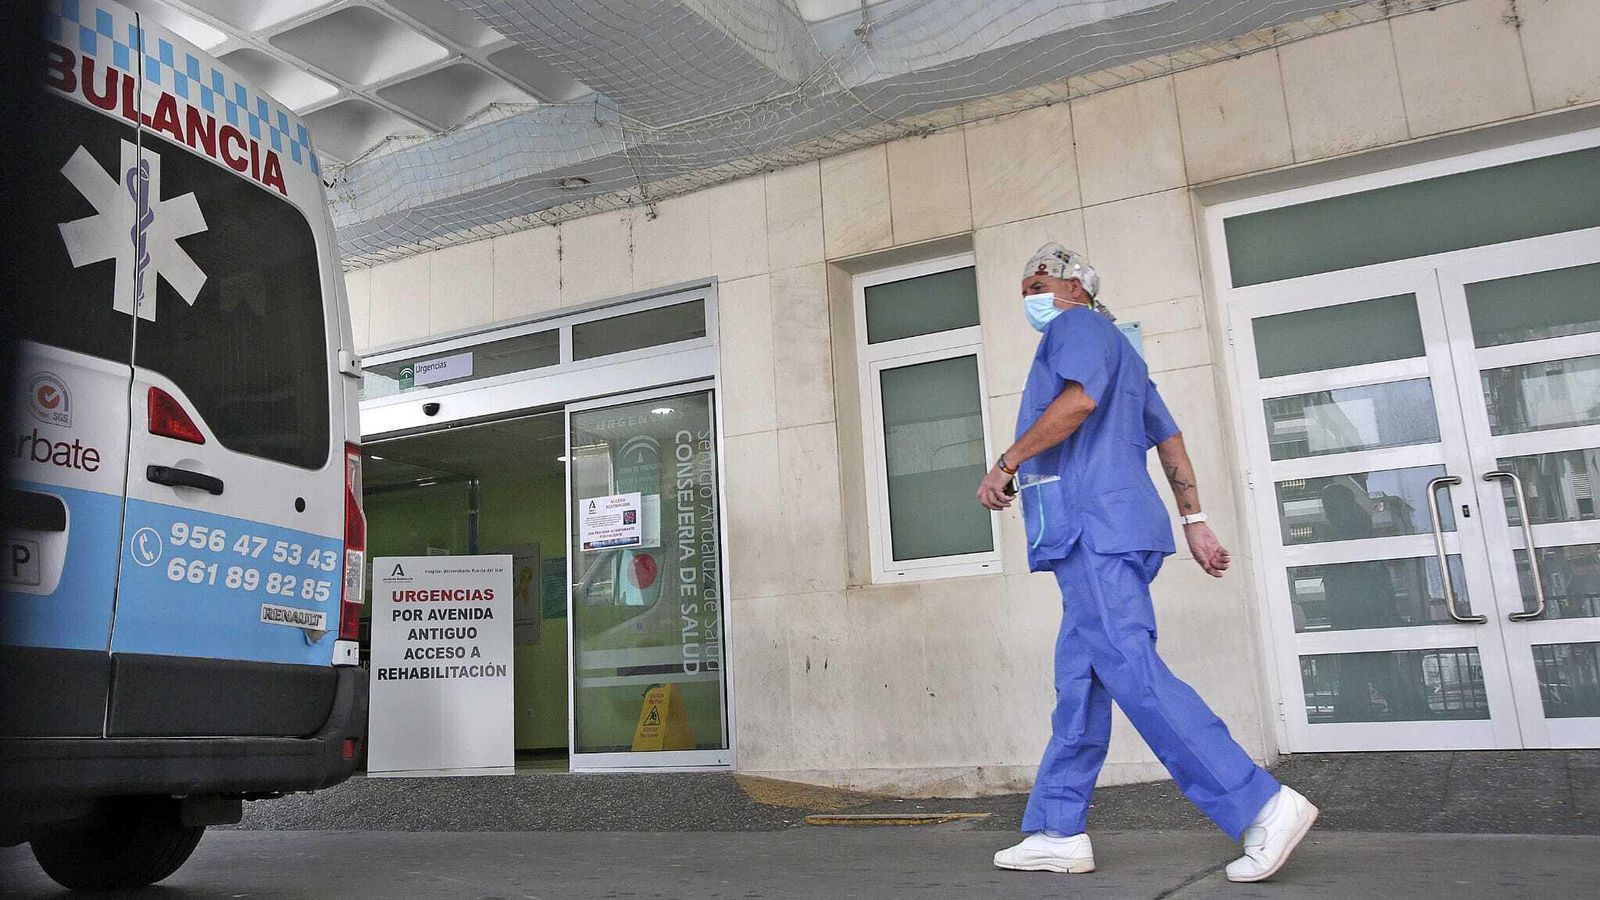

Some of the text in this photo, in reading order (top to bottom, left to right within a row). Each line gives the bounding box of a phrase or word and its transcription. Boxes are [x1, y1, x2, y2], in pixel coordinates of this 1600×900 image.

[415, 361, 447, 374] Urgencias
[53, 412, 69, 422] SGS
[12, 428, 101, 473] rbate
[170, 522, 337, 571] 956 47 53 43
[697, 430, 720, 672] Servicio Andaluz de Salud
[167, 558, 331, 602] 661 89 82 85
[679, 567, 698, 597] DE
[392, 589, 494, 602] URGENCIAS
[262, 607, 322, 627] RENAULT
[392, 608, 493, 621] POR AVENIDA
[407, 627, 477, 640] ANTIGUO
[680, 602, 700, 676] SALUD
[404, 647, 480, 660] ACCESO A
[377, 662, 507, 680] REHABILITACIÓN
